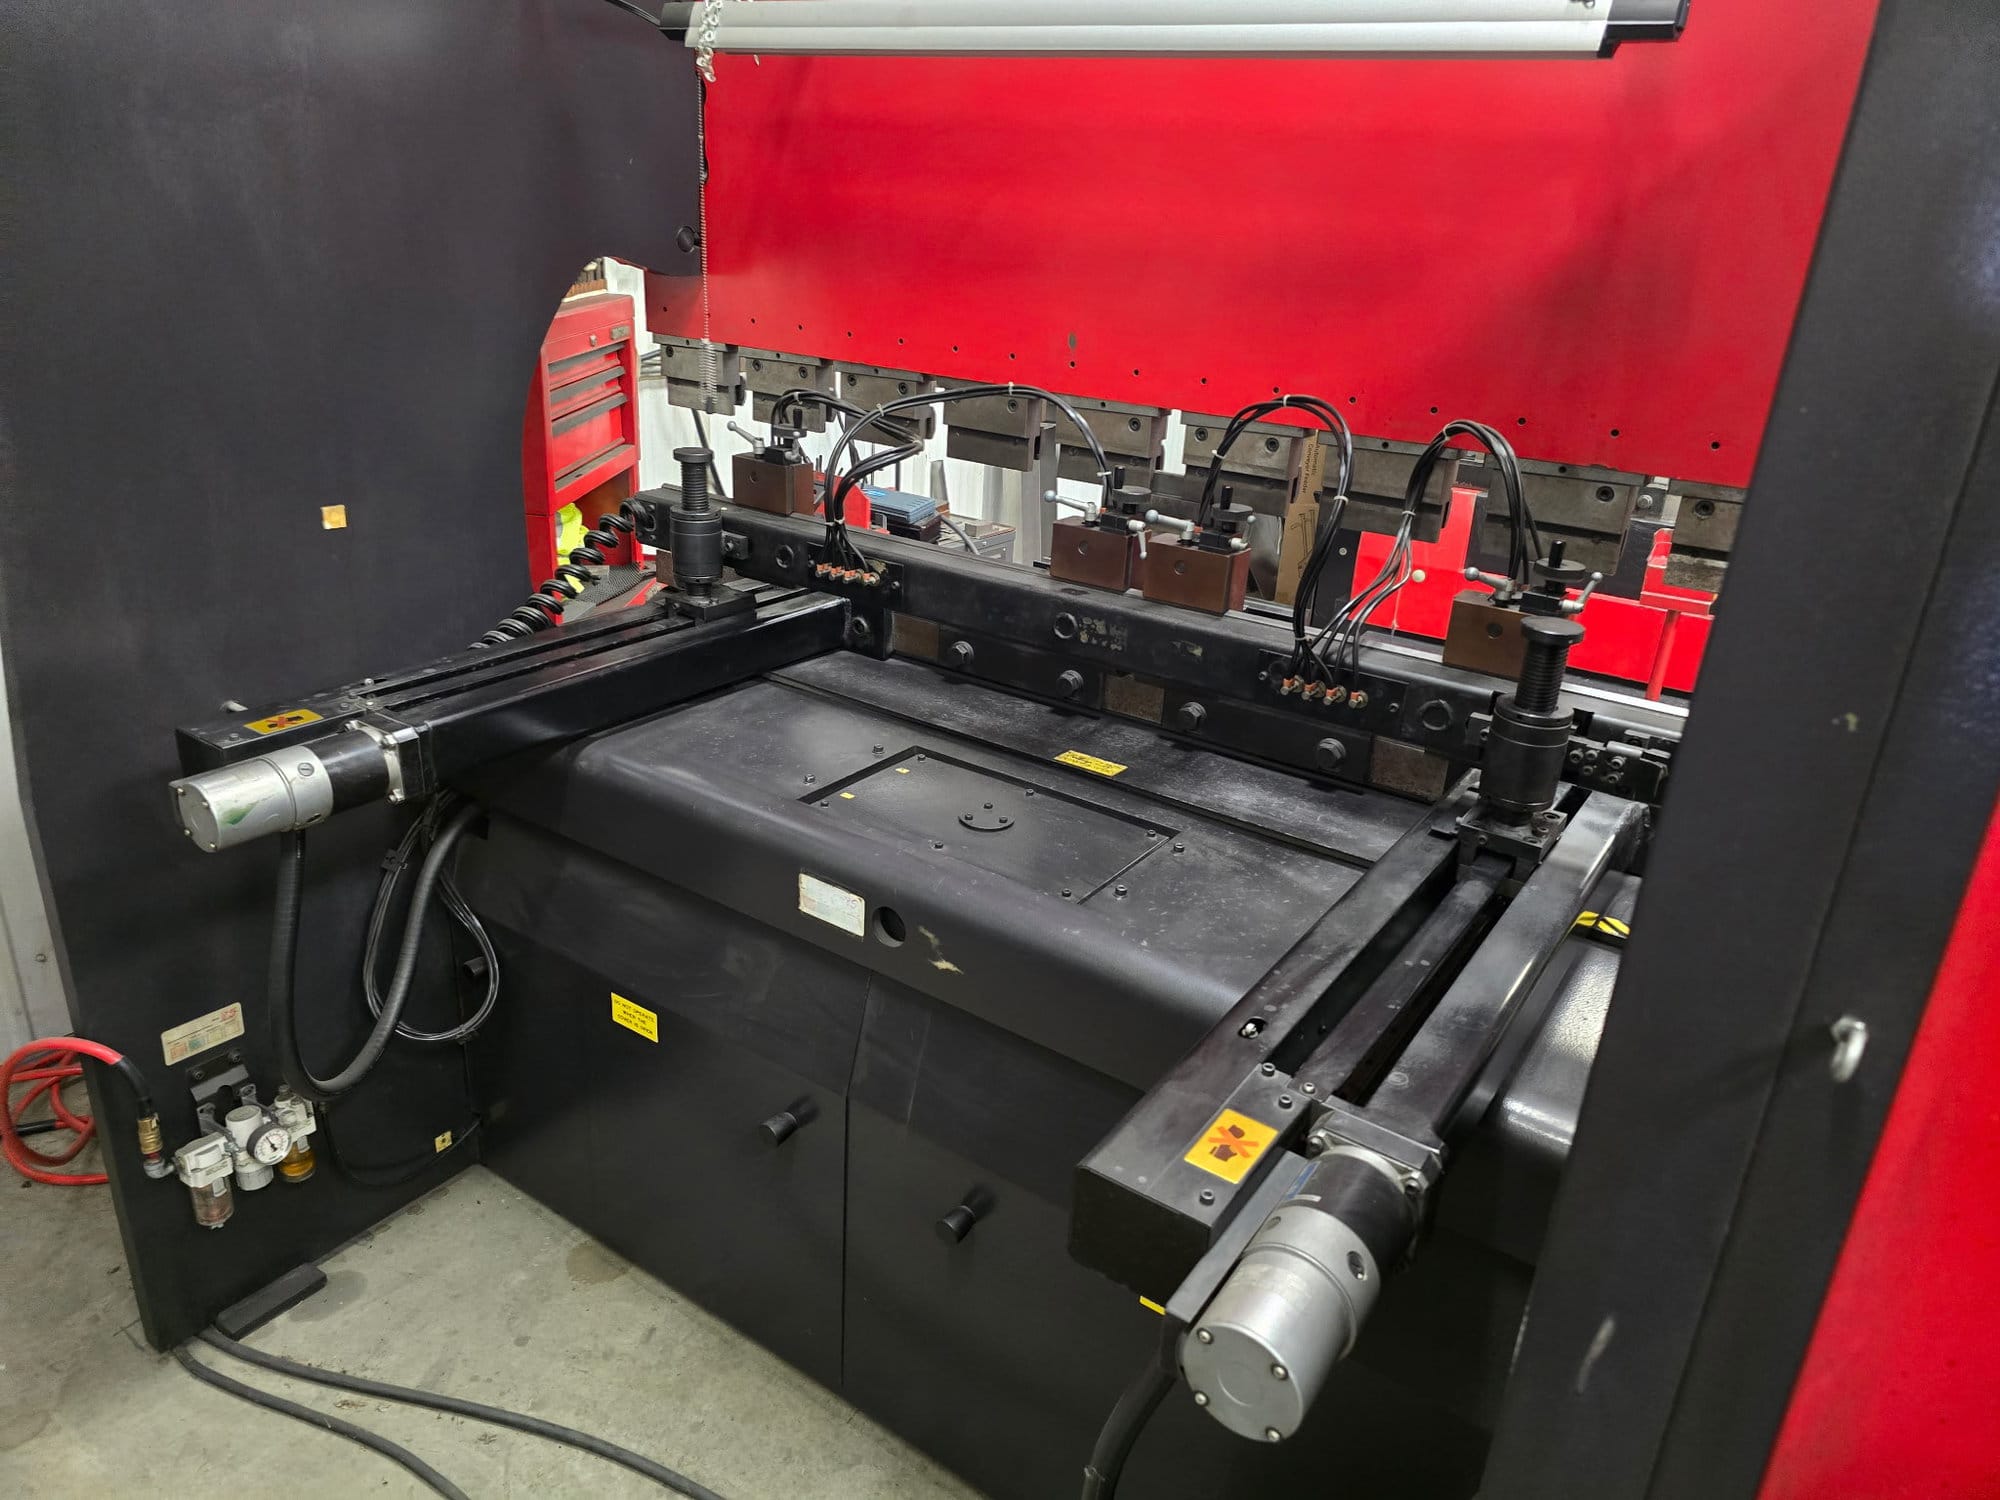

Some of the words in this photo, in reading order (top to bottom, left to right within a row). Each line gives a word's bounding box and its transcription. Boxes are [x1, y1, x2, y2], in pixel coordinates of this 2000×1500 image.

[1304, 443, 1314, 473] Conveyor
[1311, 443, 1321, 476] Automatic
[1301, 473, 1310, 494] Feeder
[617, 1014, 633, 1025] COVER
[633, 1008, 655, 1023] OPERATE
